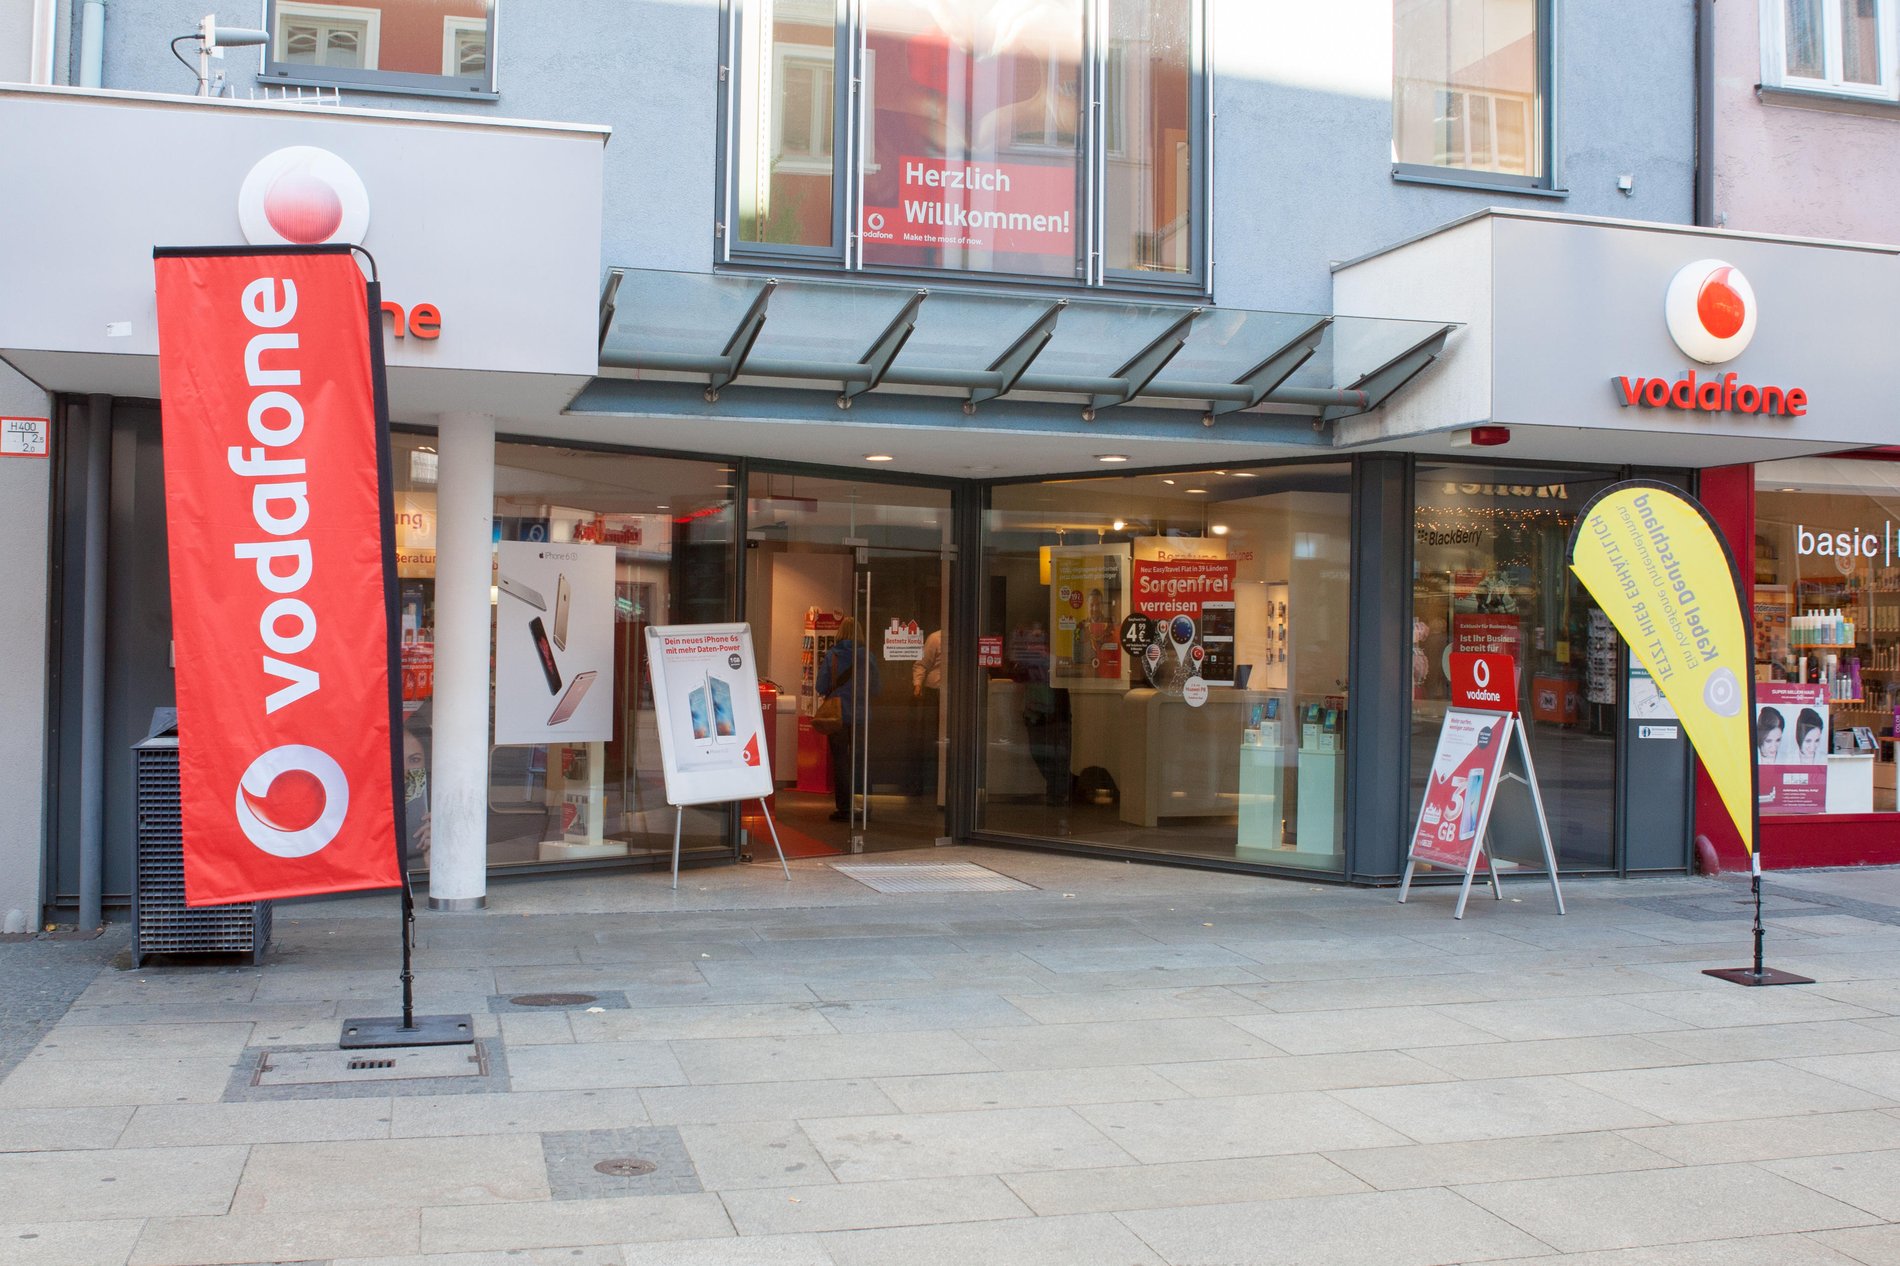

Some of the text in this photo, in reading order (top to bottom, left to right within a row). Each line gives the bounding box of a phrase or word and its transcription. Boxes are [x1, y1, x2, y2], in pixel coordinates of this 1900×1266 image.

[906, 161, 1010, 191] Herzlich
[904, 200, 1070, 234] Willkommen!
[862, 230, 894, 240] odafone
[903, 232, 984, 246] Make the most of now.
[1612, 369, 1808, 416] vodafone
[228, 277, 320, 714] vodafone
[1428, 530, 1483, 547] BlackBerry
[1798, 525, 1878, 557] basic
[545, 551, 566, 560] iPhone
[1140, 574, 1229, 597] Sorgenfrei
[1140, 599, 1198, 612] verreisen
[664, 634, 739, 645] Dein neues iPhone 6s
[1460, 634, 1472, 642] Ist
[1473, 634, 1485, 642] Ihr
[678, 646, 696, 654] mehr
[697, 645, 740, 653] Daten-Power
[1460, 644, 1500, 653] bereit für
[1466, 690, 1500, 702] vodafone
[1444, 776, 1468, 822] 3
[1438, 821, 1456, 842] GB
